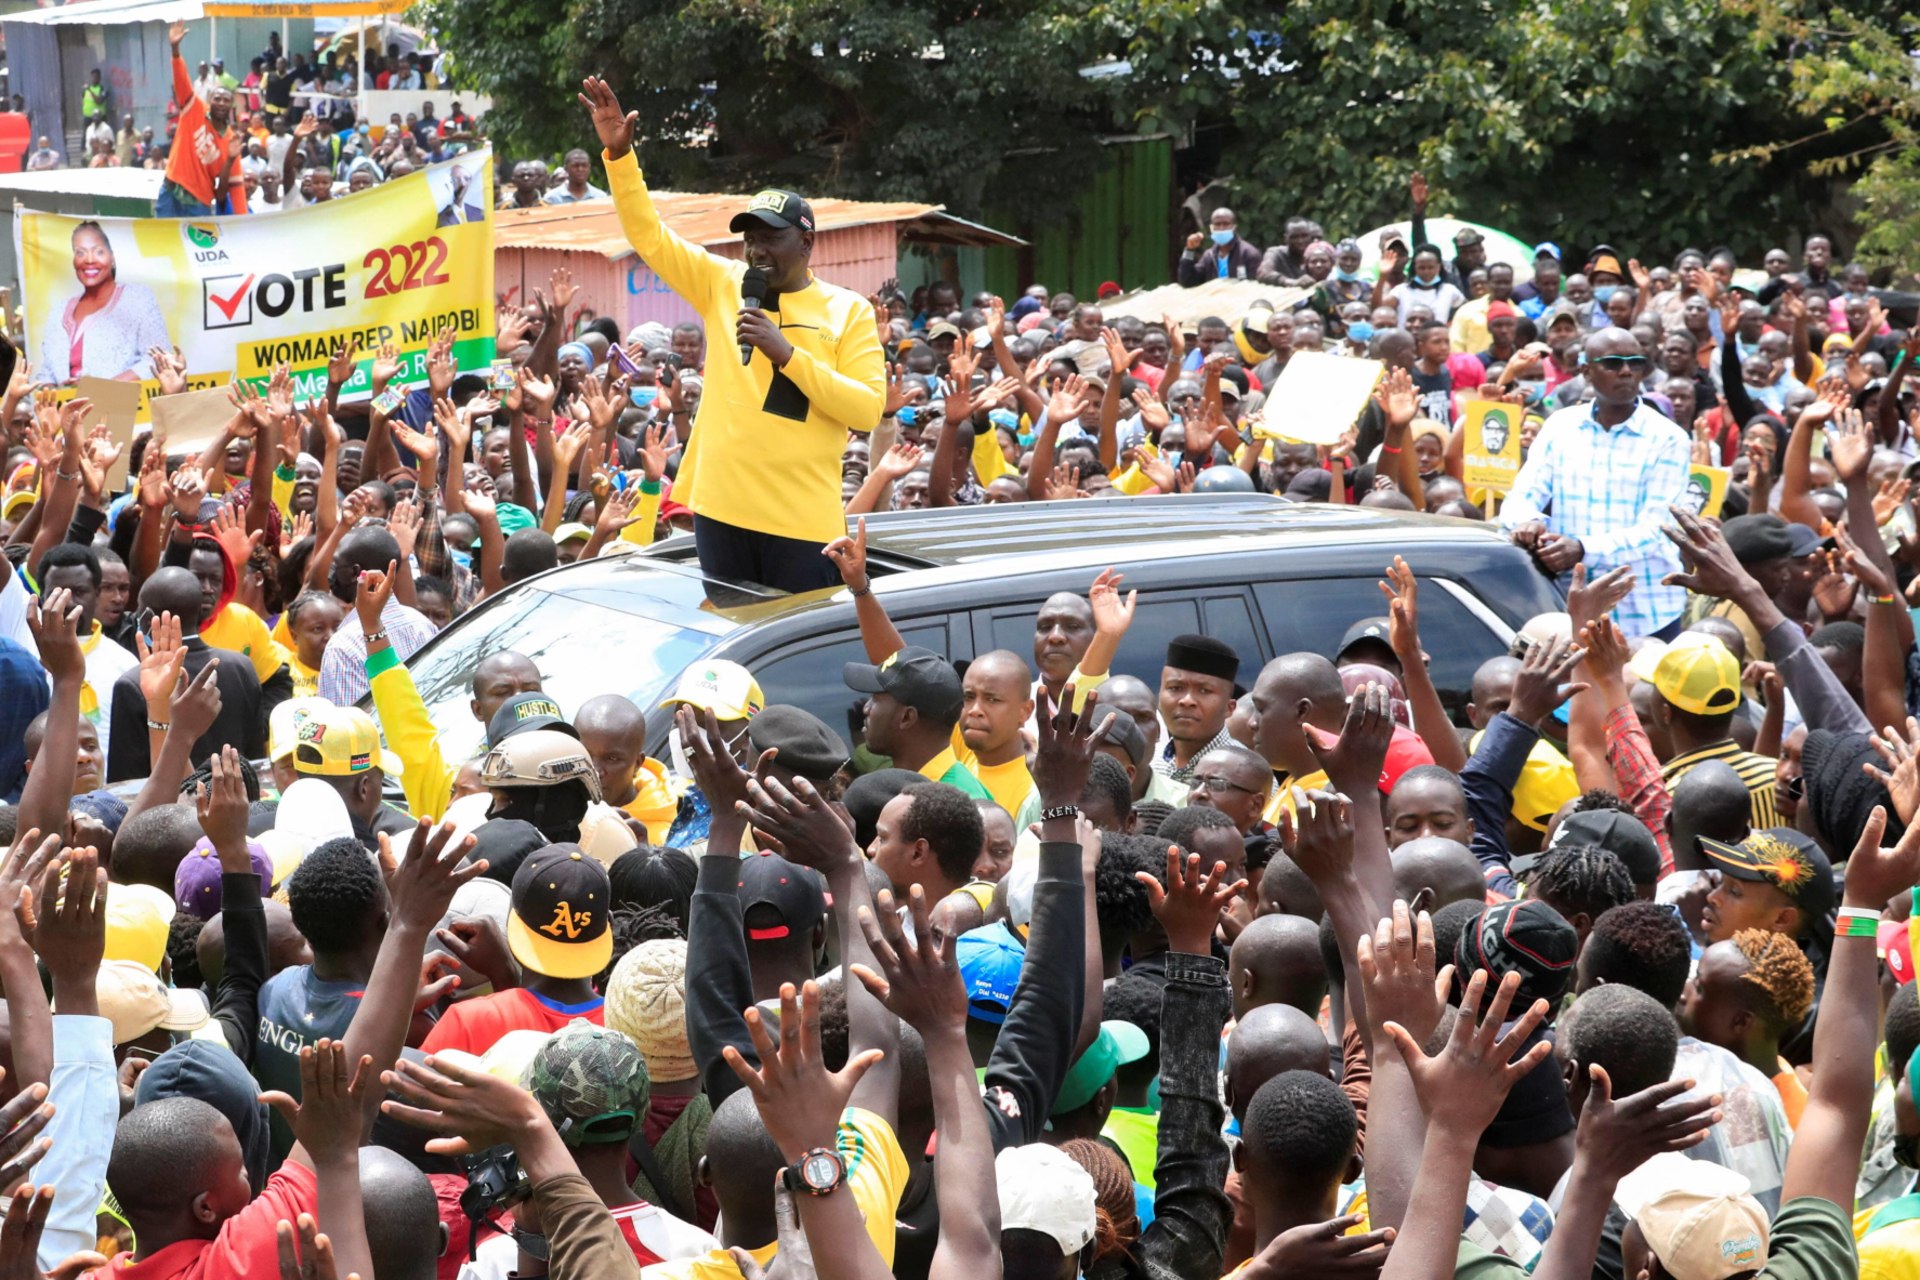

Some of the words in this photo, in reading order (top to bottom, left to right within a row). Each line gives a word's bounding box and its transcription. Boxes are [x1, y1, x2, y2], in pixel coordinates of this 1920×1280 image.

[195, 250, 229, 263] UDA
[363, 236, 449, 299] 2022
[253, 334, 345, 368] WOMAN
[351, 326, 393, 351] REP
[517, 701, 560, 718] HUSTLE
[540, 901, 592, 939] A's
[259, 1016, 318, 1056] ENGLA
